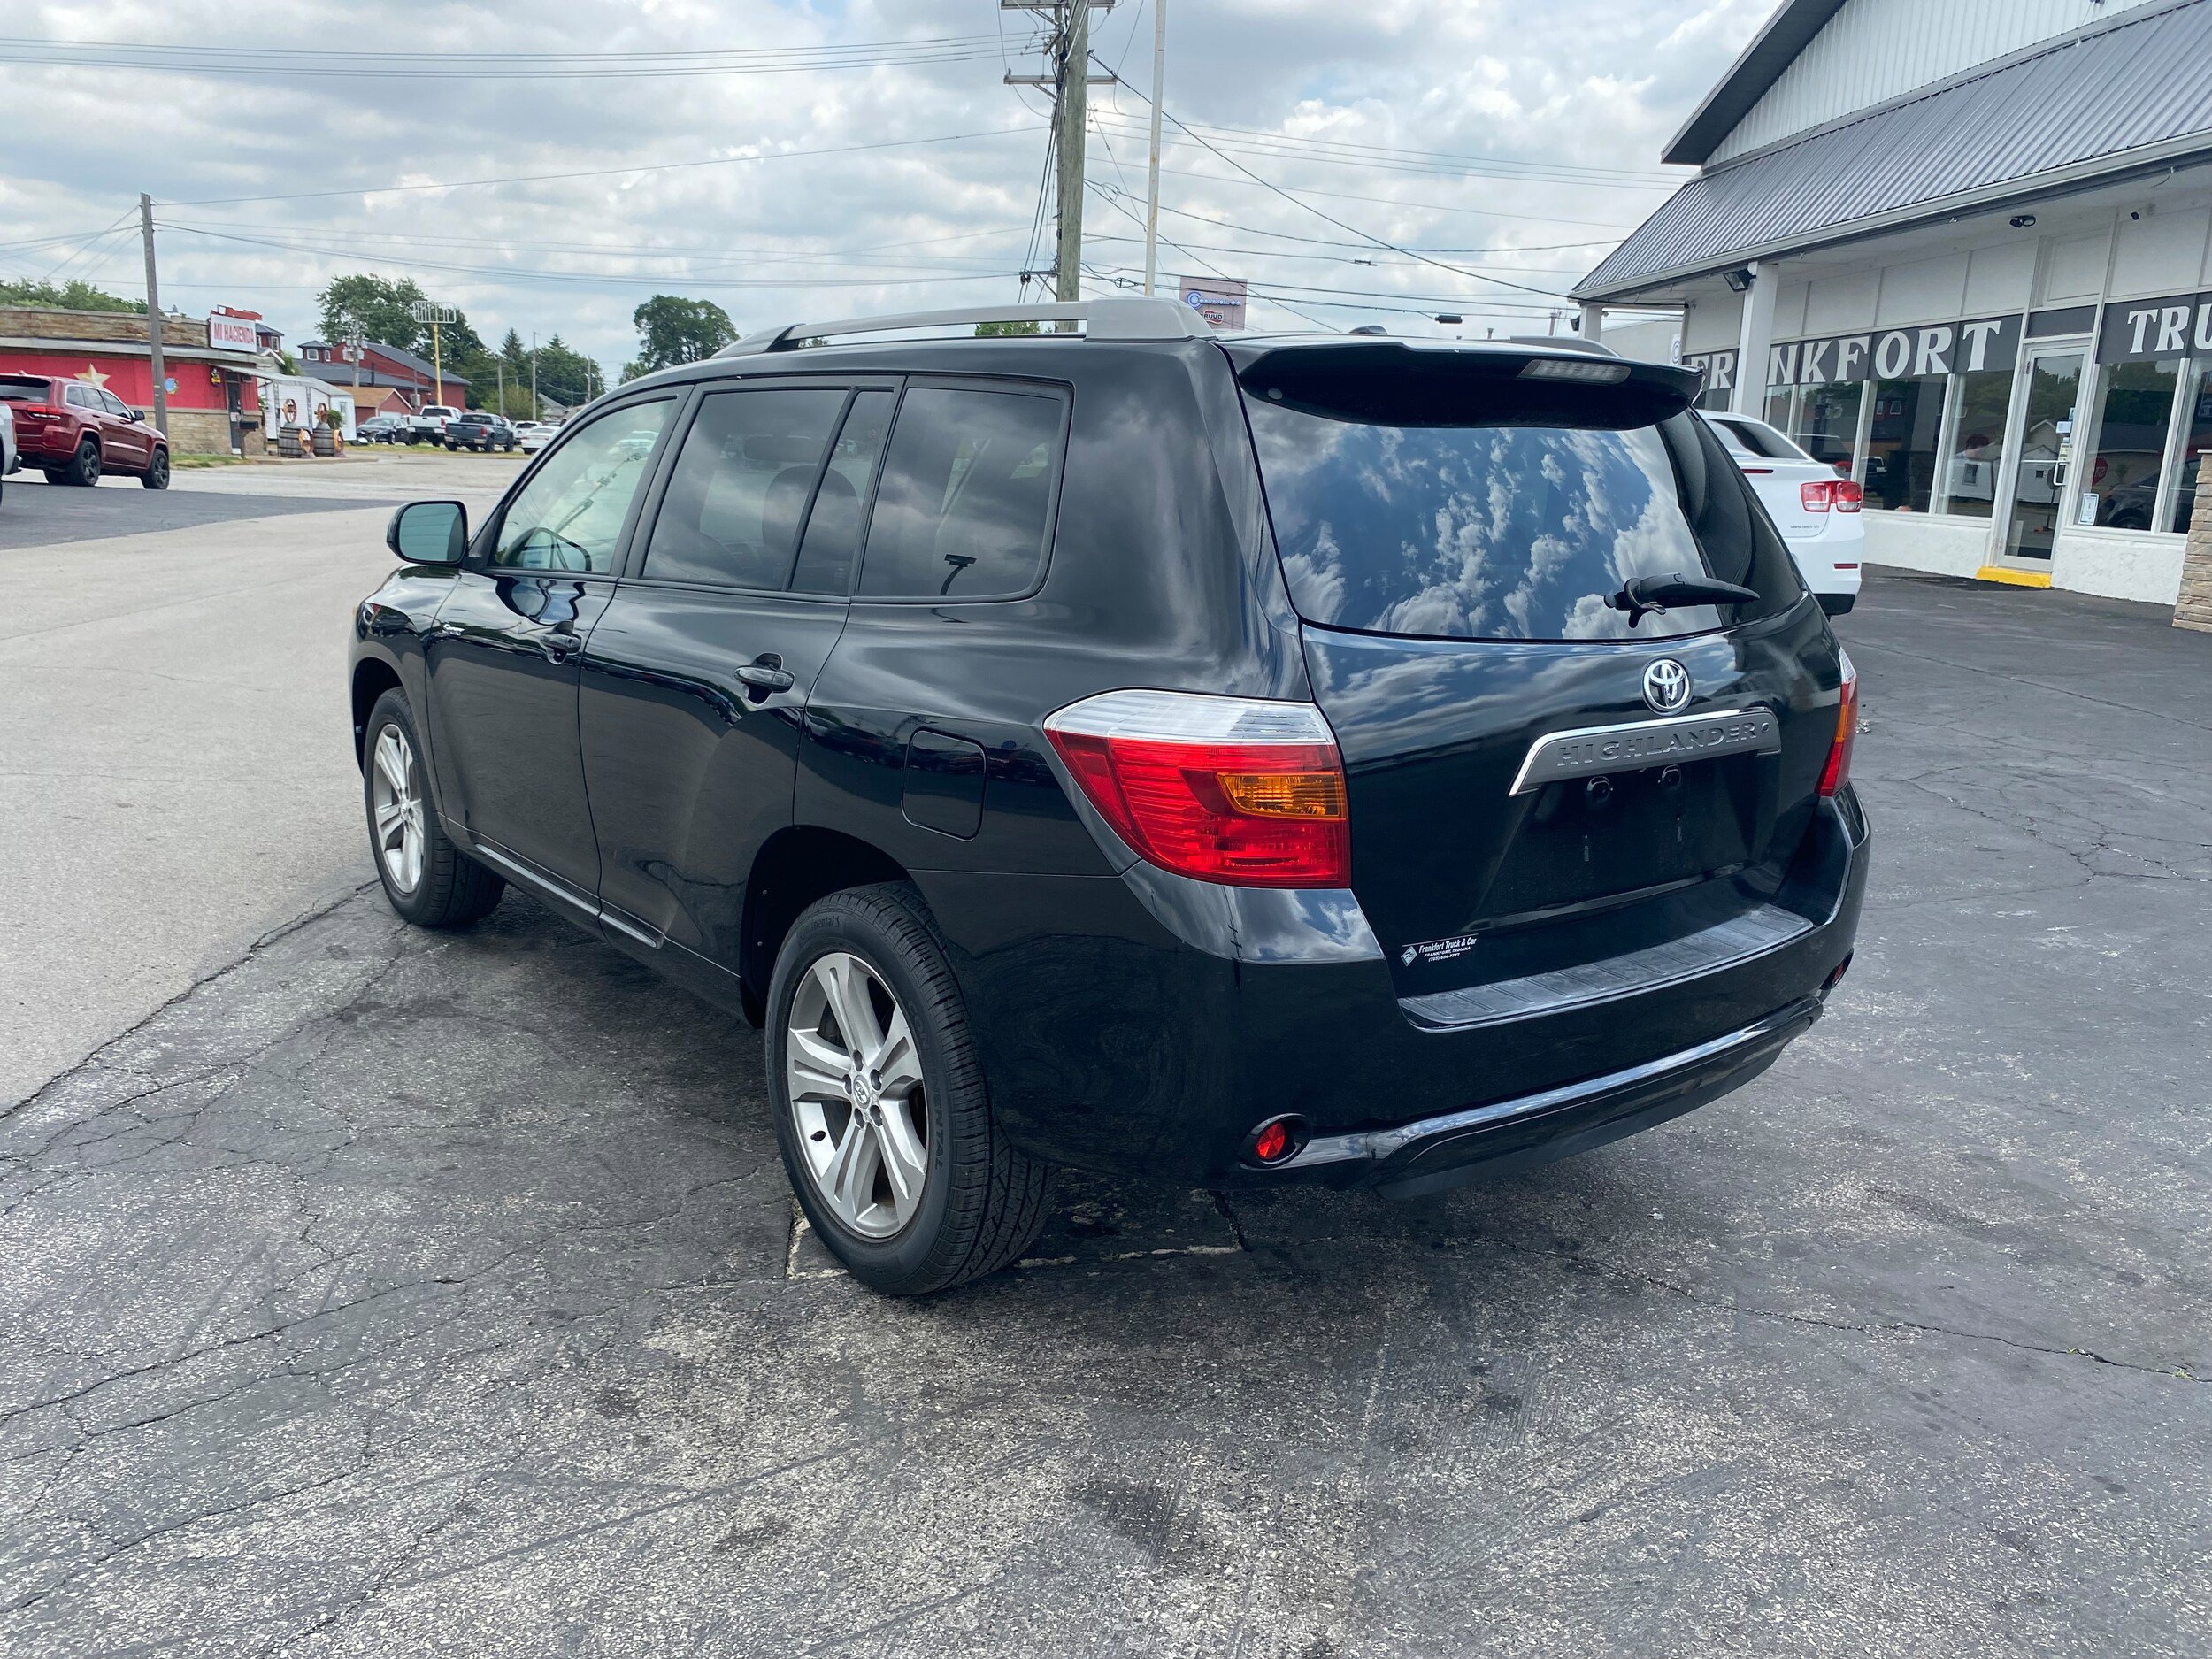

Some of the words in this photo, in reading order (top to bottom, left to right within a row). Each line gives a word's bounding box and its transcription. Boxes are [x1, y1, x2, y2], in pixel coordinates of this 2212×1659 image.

[213, 322, 222, 340] MI
[224, 324, 255, 344] HACIENDA
[1691, 320, 2001, 389] RNKFORT
[1557, 722, 1756, 766] HIGHLANDER
[1418, 942, 1445, 954] Frankfort
[1445, 940, 1460, 949] Truck
